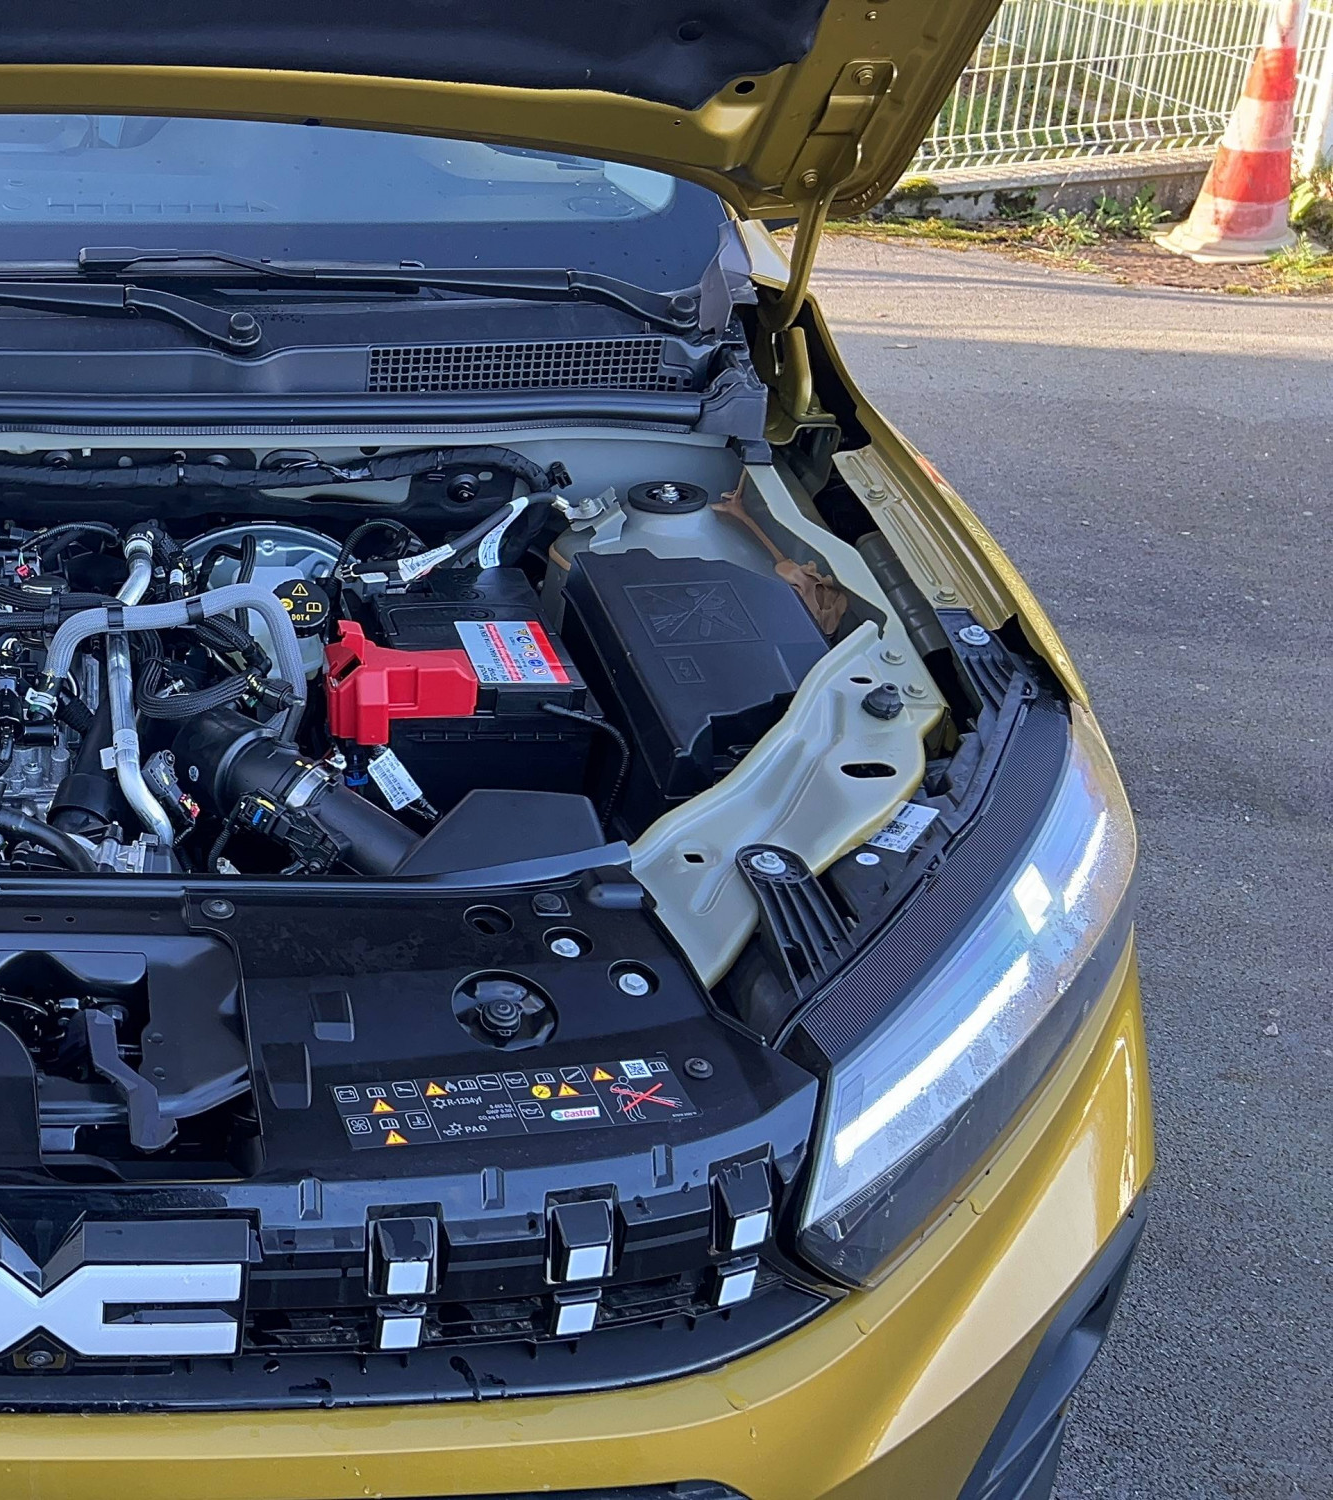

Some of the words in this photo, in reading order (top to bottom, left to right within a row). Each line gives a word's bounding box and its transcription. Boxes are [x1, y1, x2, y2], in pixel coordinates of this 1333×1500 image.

[447, 1096, 482, 1106] R-1234yf
[563, 1109, 597, 1118] Castrol
[464, 1124, 488, 1134] PAG
